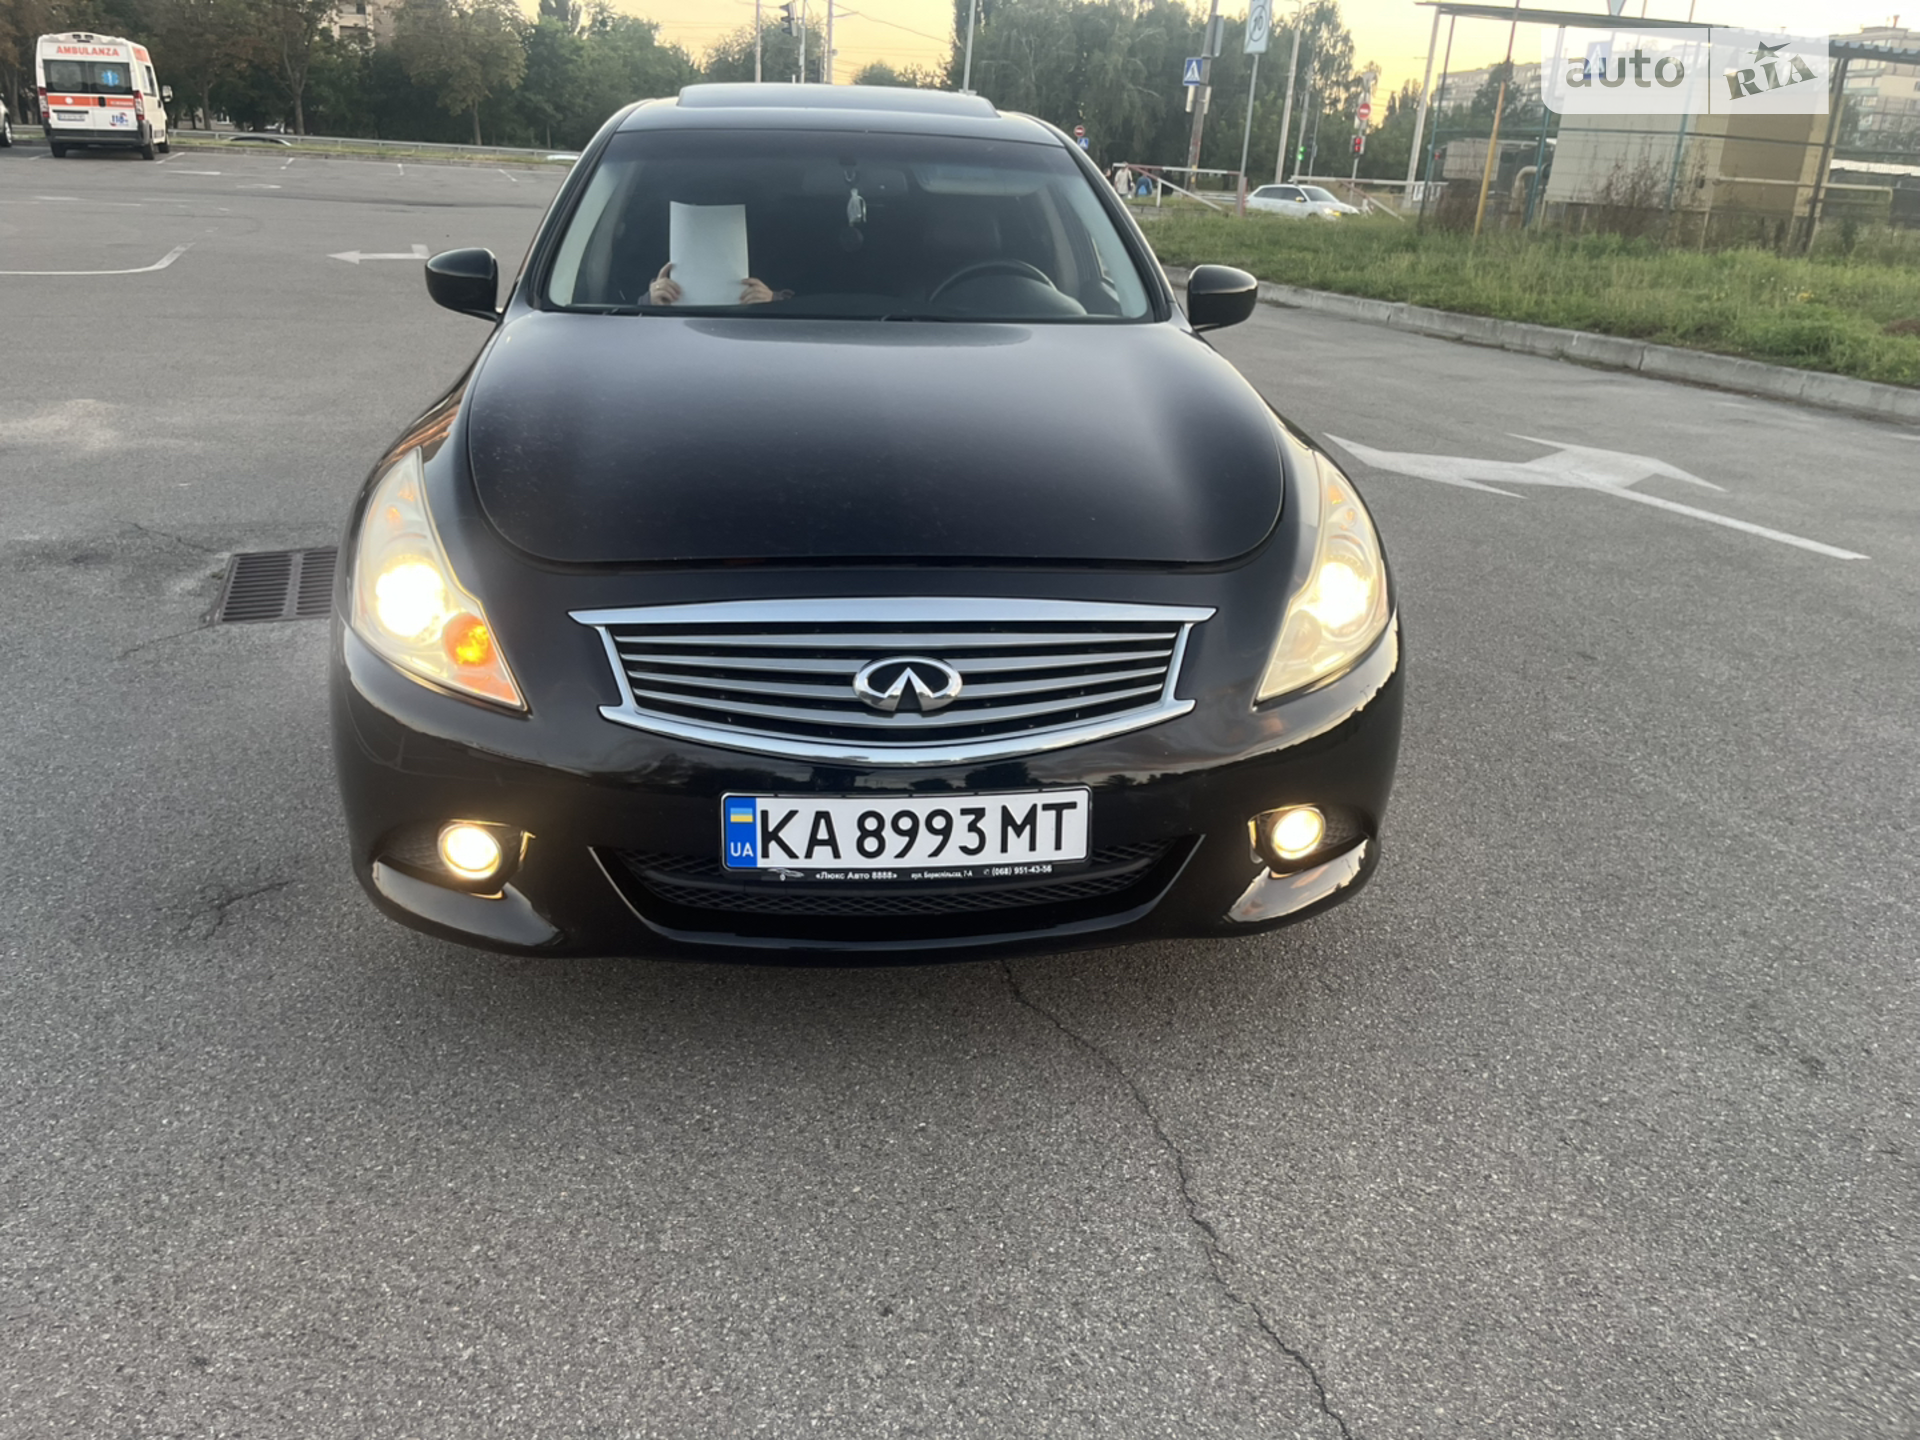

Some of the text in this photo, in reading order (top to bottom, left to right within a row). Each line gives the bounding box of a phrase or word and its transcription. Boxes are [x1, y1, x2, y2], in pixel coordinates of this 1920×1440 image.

[56, 45, 120, 57] AMBULANZA
[760, 801, 1078, 859] KA 8993 MT
[731, 842, 754, 857] UA
[847, 871, 870, 880] Авто
